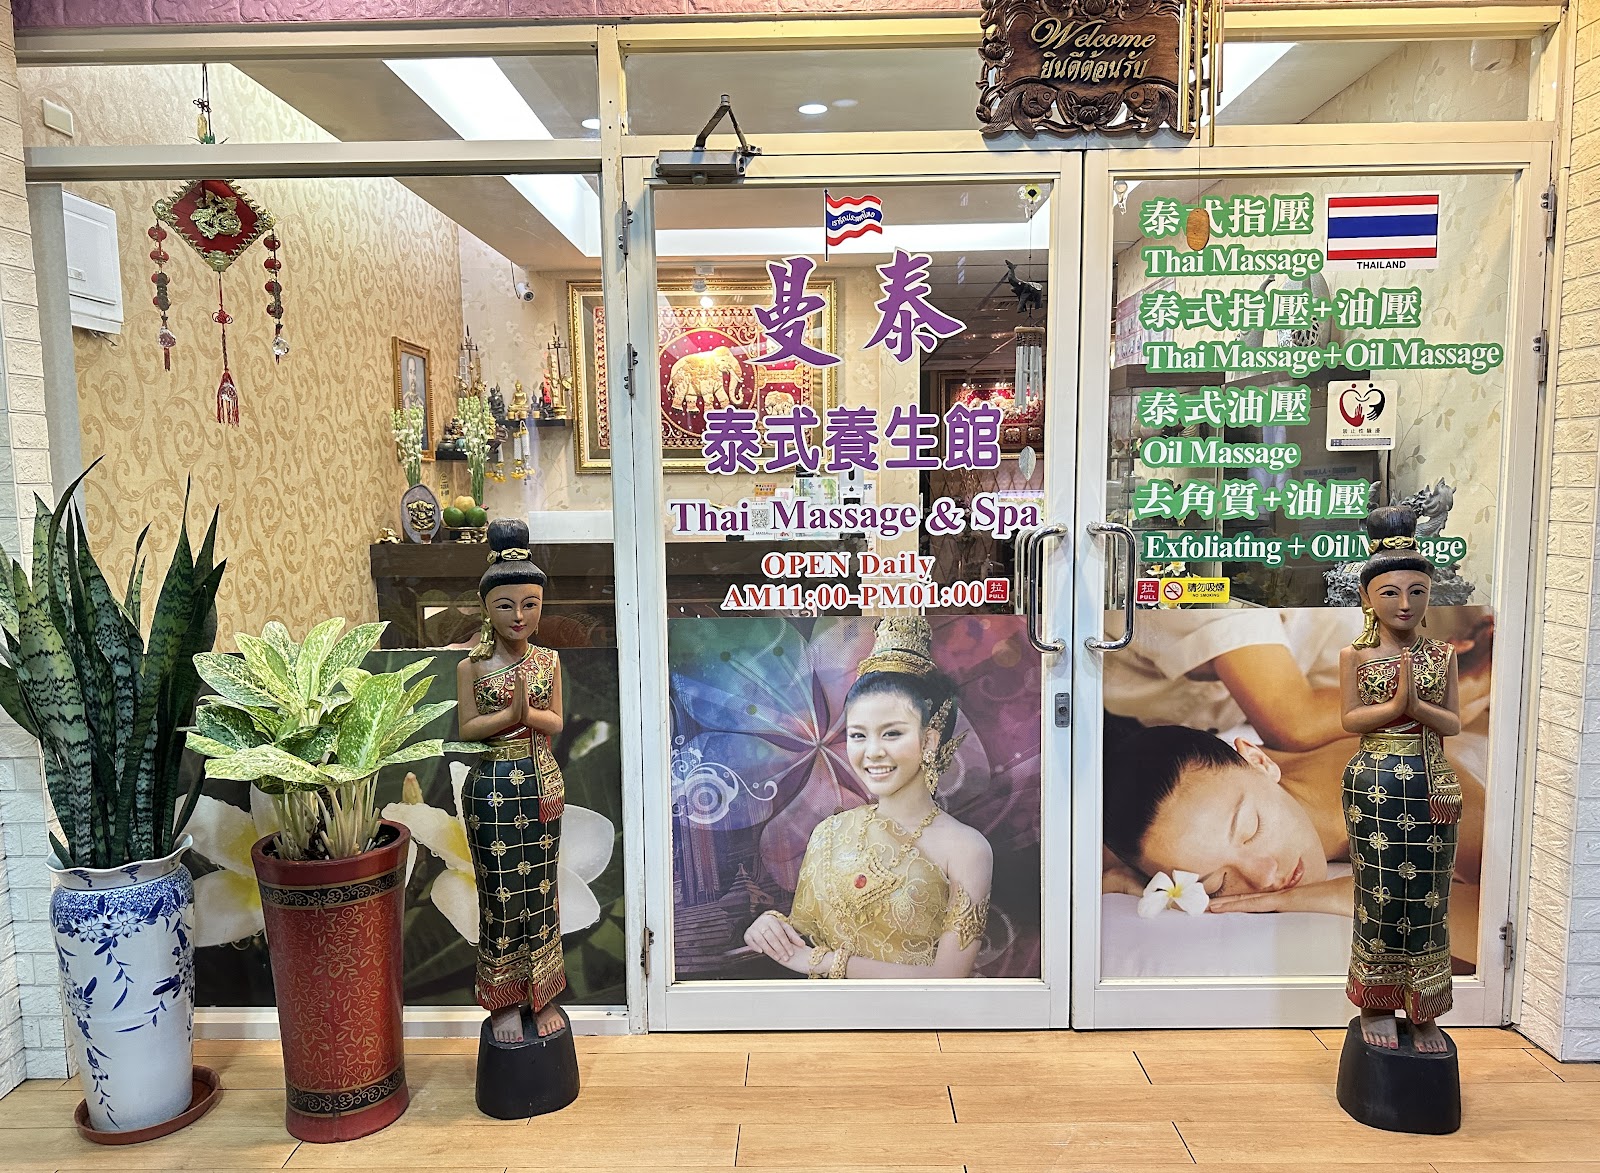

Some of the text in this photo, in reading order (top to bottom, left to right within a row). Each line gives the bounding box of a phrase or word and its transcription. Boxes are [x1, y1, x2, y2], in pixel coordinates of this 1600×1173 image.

[1030, 18, 1156, 49] Welcome
[1040, 50, 1150, 82] ยินดีต้อนรับ
[1144, 247, 1321, 277] Thai Massage
[1356, 260, 1407, 270] THAILAND
[1142, 290, 1419, 328] 泰式指壓+油壓
[1146, 345, 1206, 369] Thai
[1389, 342, 1500, 371] Massage
[1141, 388, 1308, 424] 泰式油壓
[704, 404, 1001, 472] 泰式養生館
[1143, 439, 1298, 471] Oil Massage
[1135, 482, 1367, 518] 去角質+油壓
[671, 497, 1041, 537] Thai Massage & Spa
[1146, 536, 1282, 565] Exfoliating
[1288, 540, 1306, 558] +
[1311, 535, 1350, 558] Oil
[763, 553, 936, 580] OPEN Daily
[724, 583, 984, 608] AM11:00-PM01:00
[990, 582, 1005, 593] 拉
[1140, 583, 1156, 594] 拉
